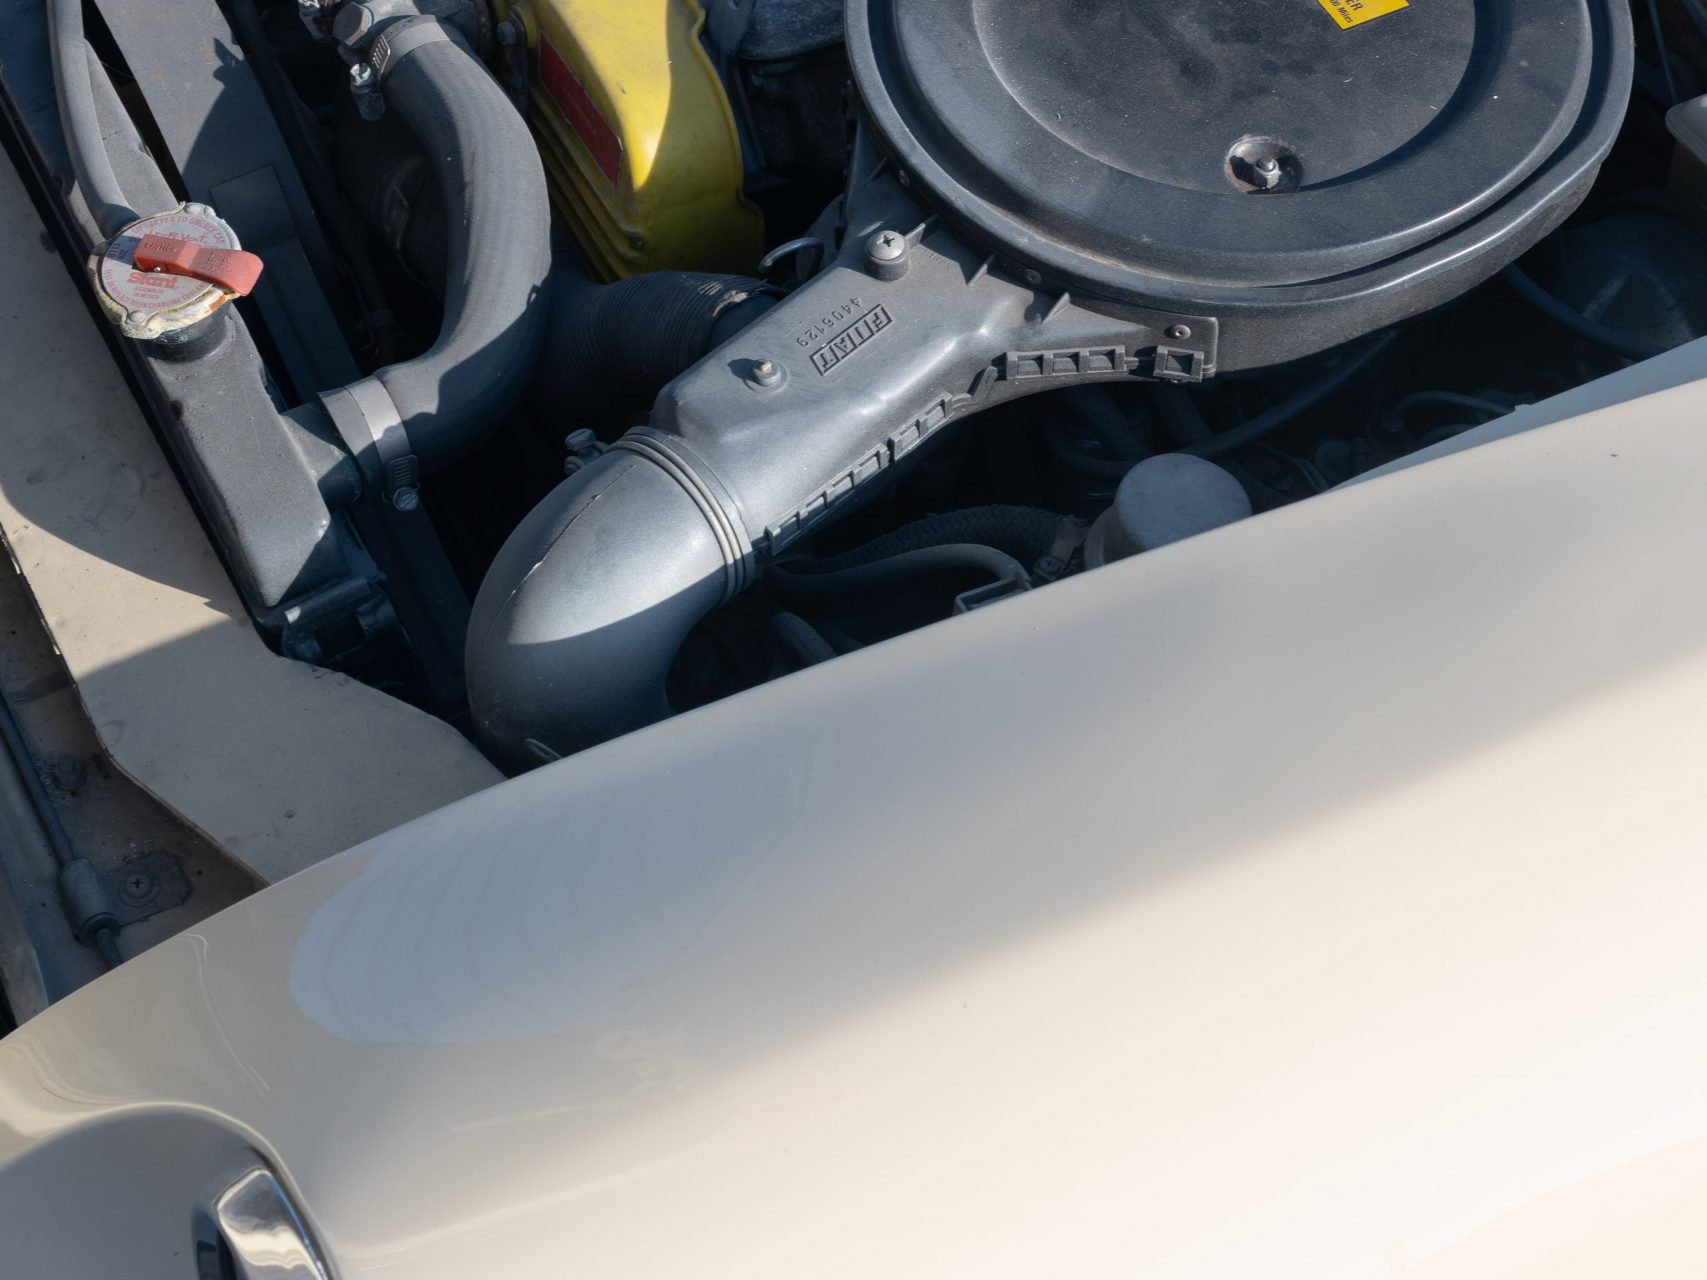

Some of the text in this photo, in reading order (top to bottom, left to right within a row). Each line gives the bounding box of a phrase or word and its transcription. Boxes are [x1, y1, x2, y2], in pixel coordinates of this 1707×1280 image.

[1337, 7, 1353, 24] Miles
[126, 271, 178, 289] Stant
[796, 297, 863, 348] 4406129
[813, 307, 889, 373] FIAT
